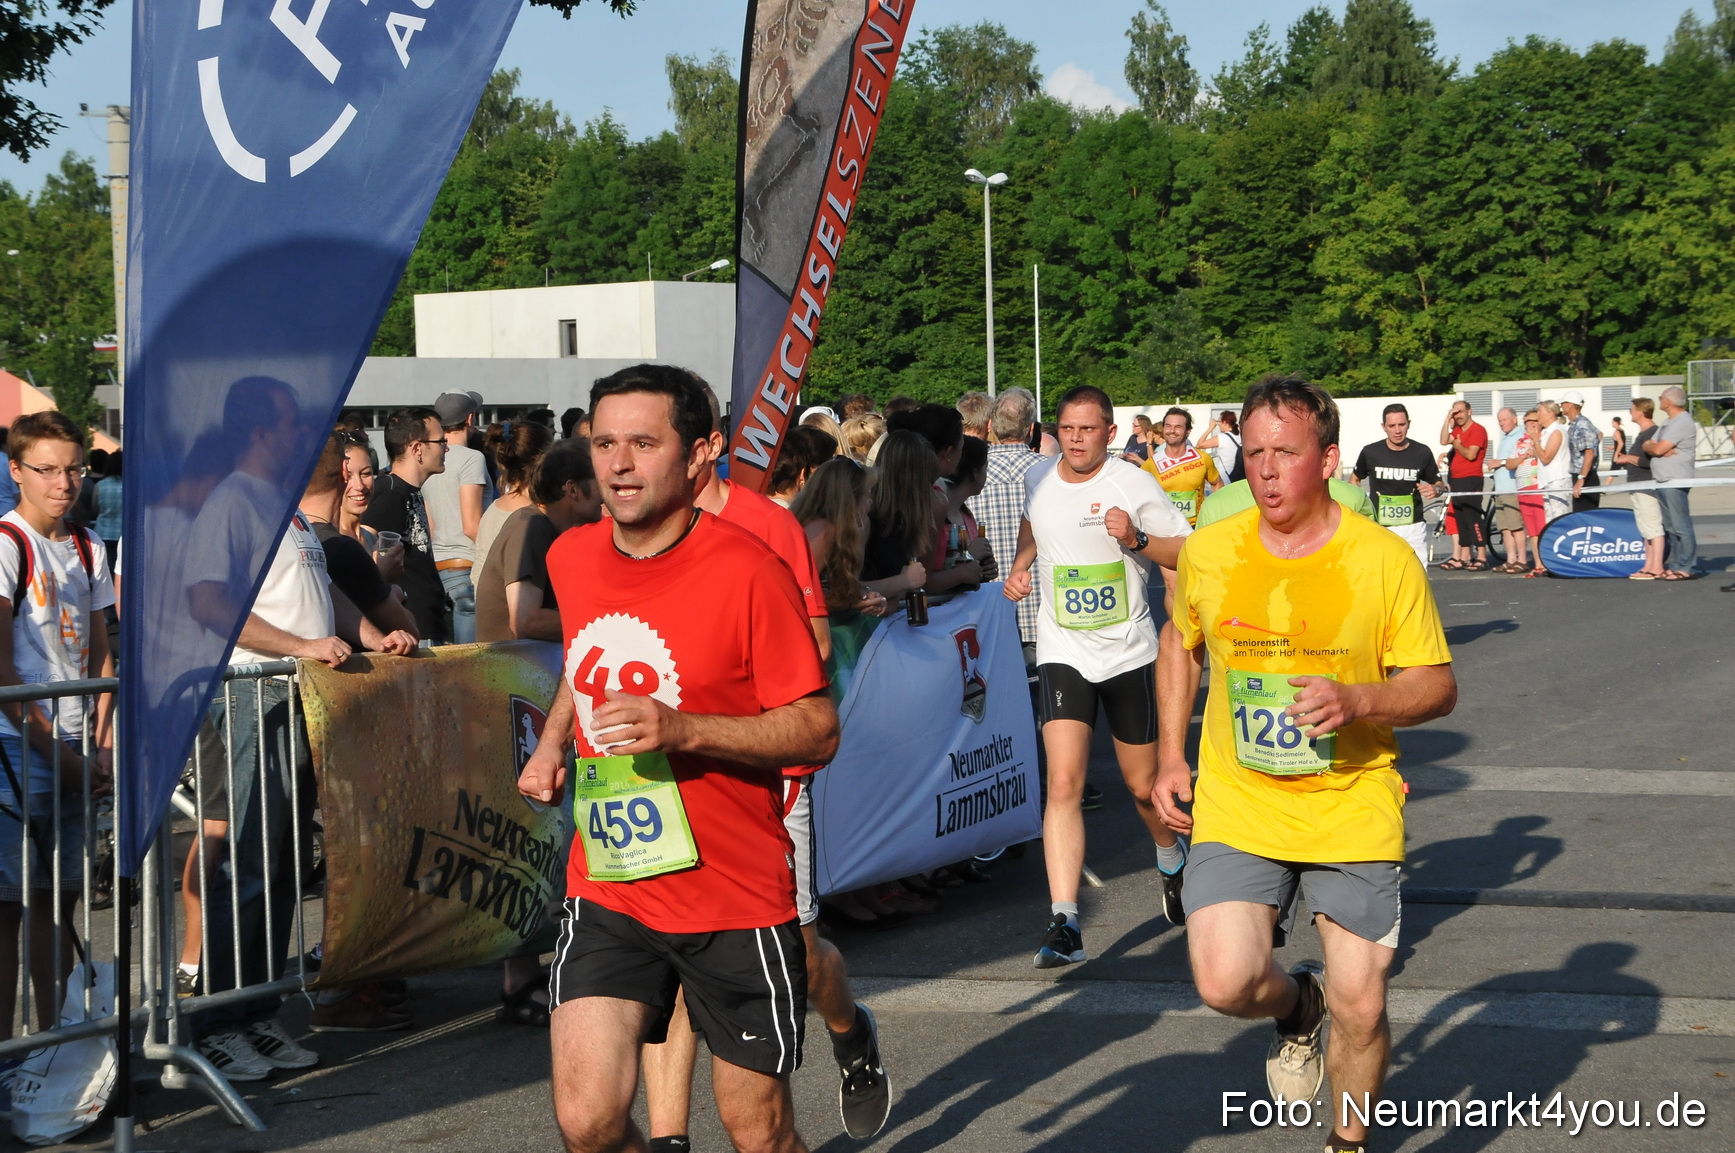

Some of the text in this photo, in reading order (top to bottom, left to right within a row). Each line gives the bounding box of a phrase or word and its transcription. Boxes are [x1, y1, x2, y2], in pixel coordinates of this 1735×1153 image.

[1160, 461, 1204, 482] MAX BÖGL
[1374, 466, 1418, 481] THULE
[1380, 506, 1412, 518] 1399
[1571, 538, 1648, 556] Fische
[1578, 553, 1647, 563] AUTOMOBILE
[1065, 585, 1117, 614] 898
[1232, 638, 1290, 648] Seniorenstift
[1249, 648, 1277, 657] Tiroler
[1279, 647, 1296, 656] Hof
[1302, 647, 1350, 656] Neumarkt
[948, 733, 1013, 782] Neumarkter
[936, 766, 1027, 838] Lammsbräu
[588, 796, 663, 850] 459
[620, 848, 647, 860] Vaglica
[641, 854, 664, 865] GmbH
